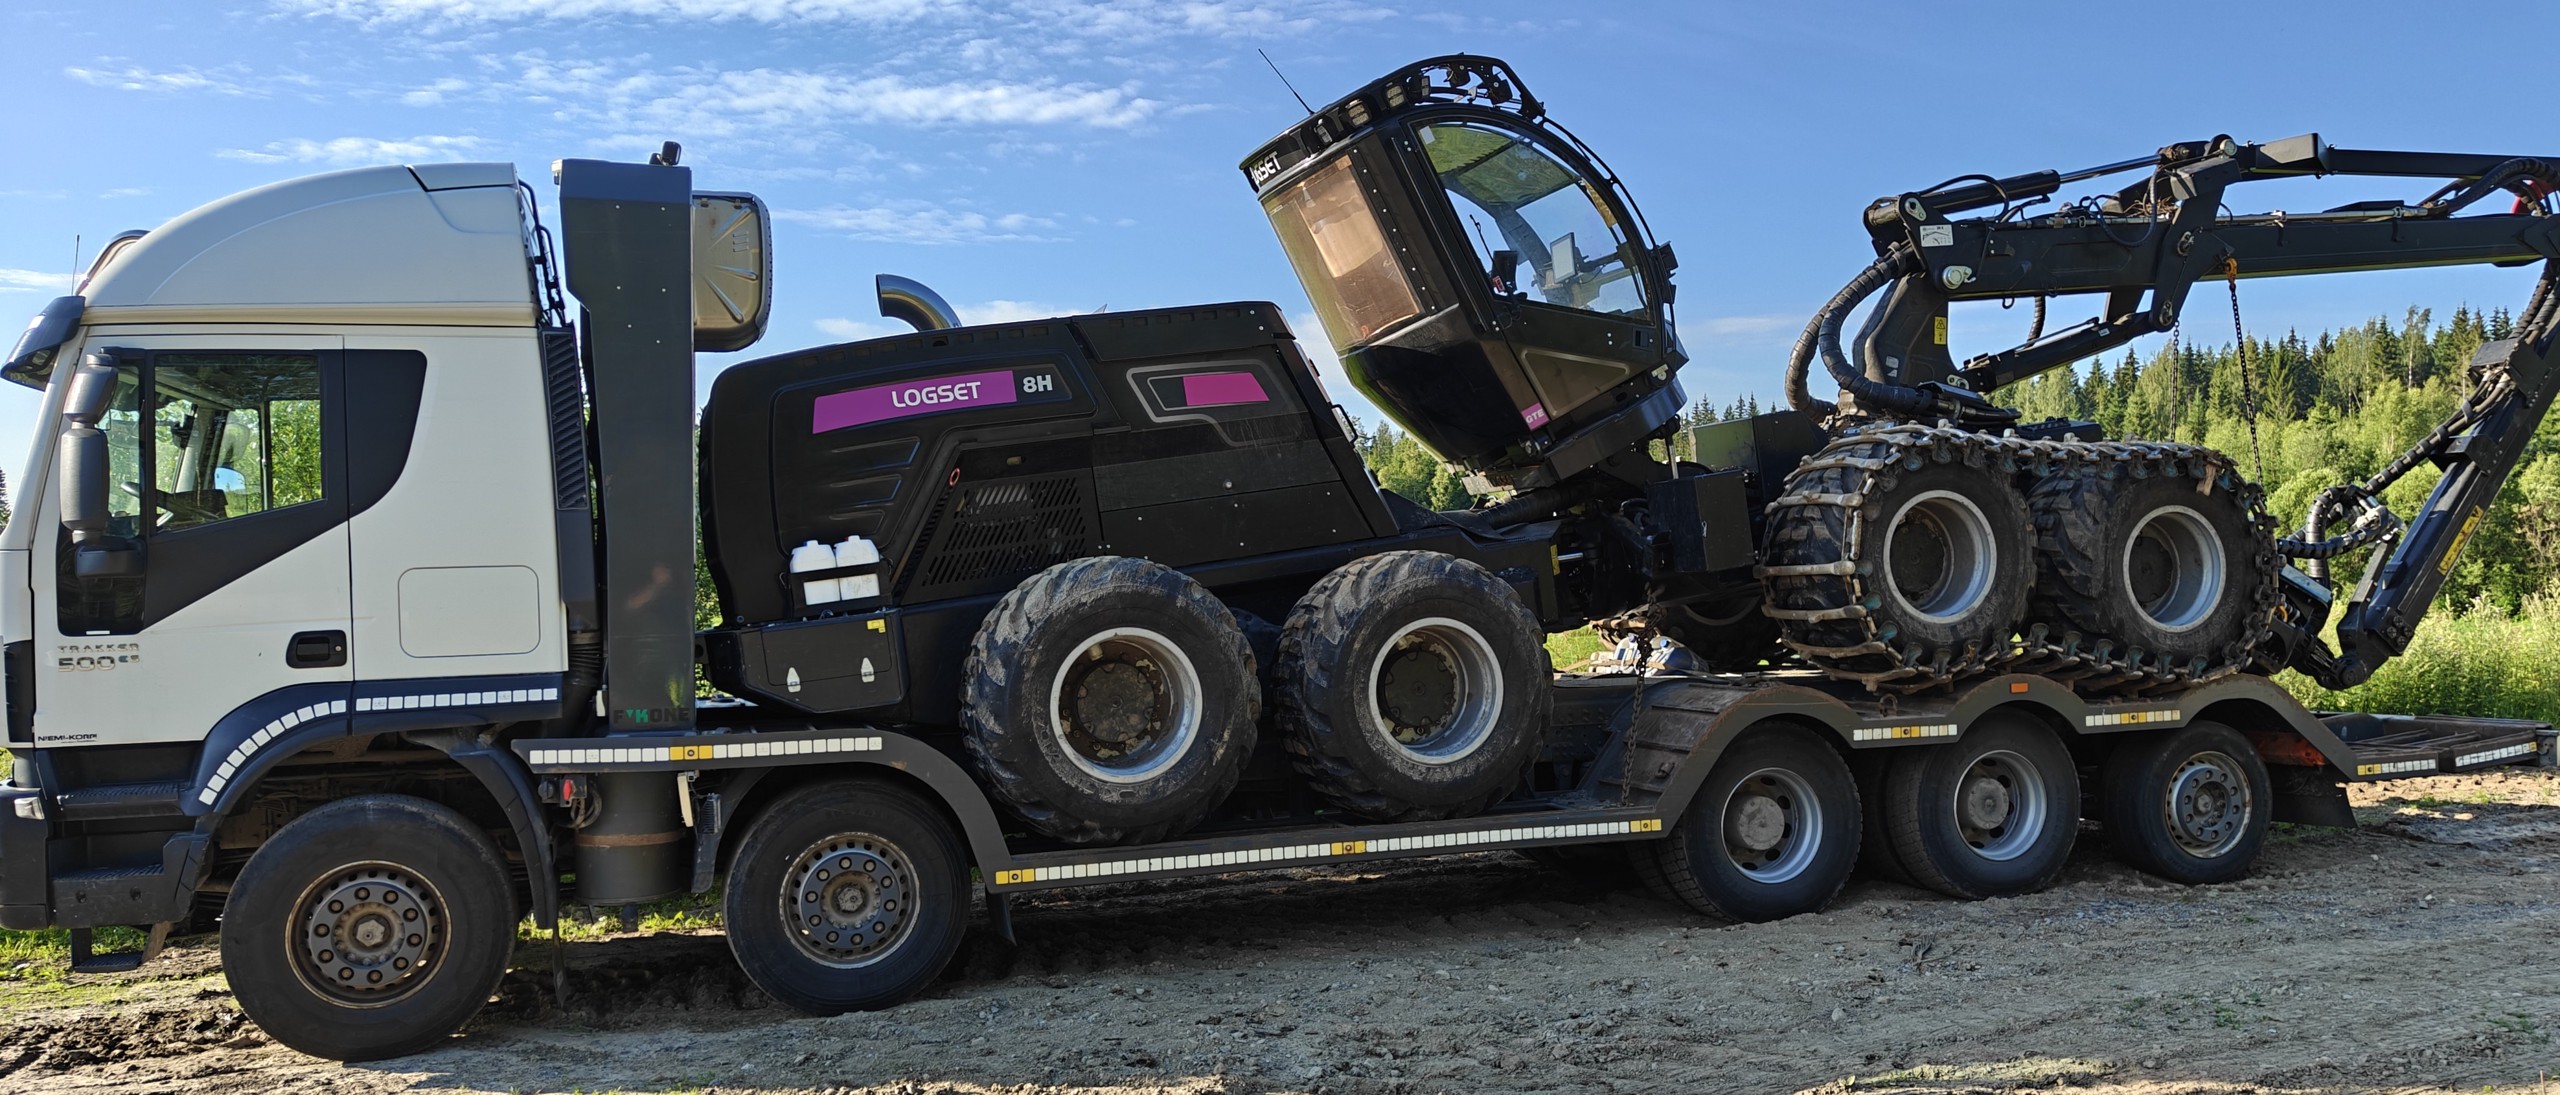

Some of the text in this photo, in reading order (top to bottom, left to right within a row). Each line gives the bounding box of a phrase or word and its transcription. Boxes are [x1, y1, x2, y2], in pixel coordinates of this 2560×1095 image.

[891, 374, 1053, 408] LOGSET 8H
[1525, 408, 1545, 424] GTE
[57, 643, 139, 654] TRAKKER
[58, 655, 116, 672] 500
[38, 733, 98, 742] NIEMI-KORPI
